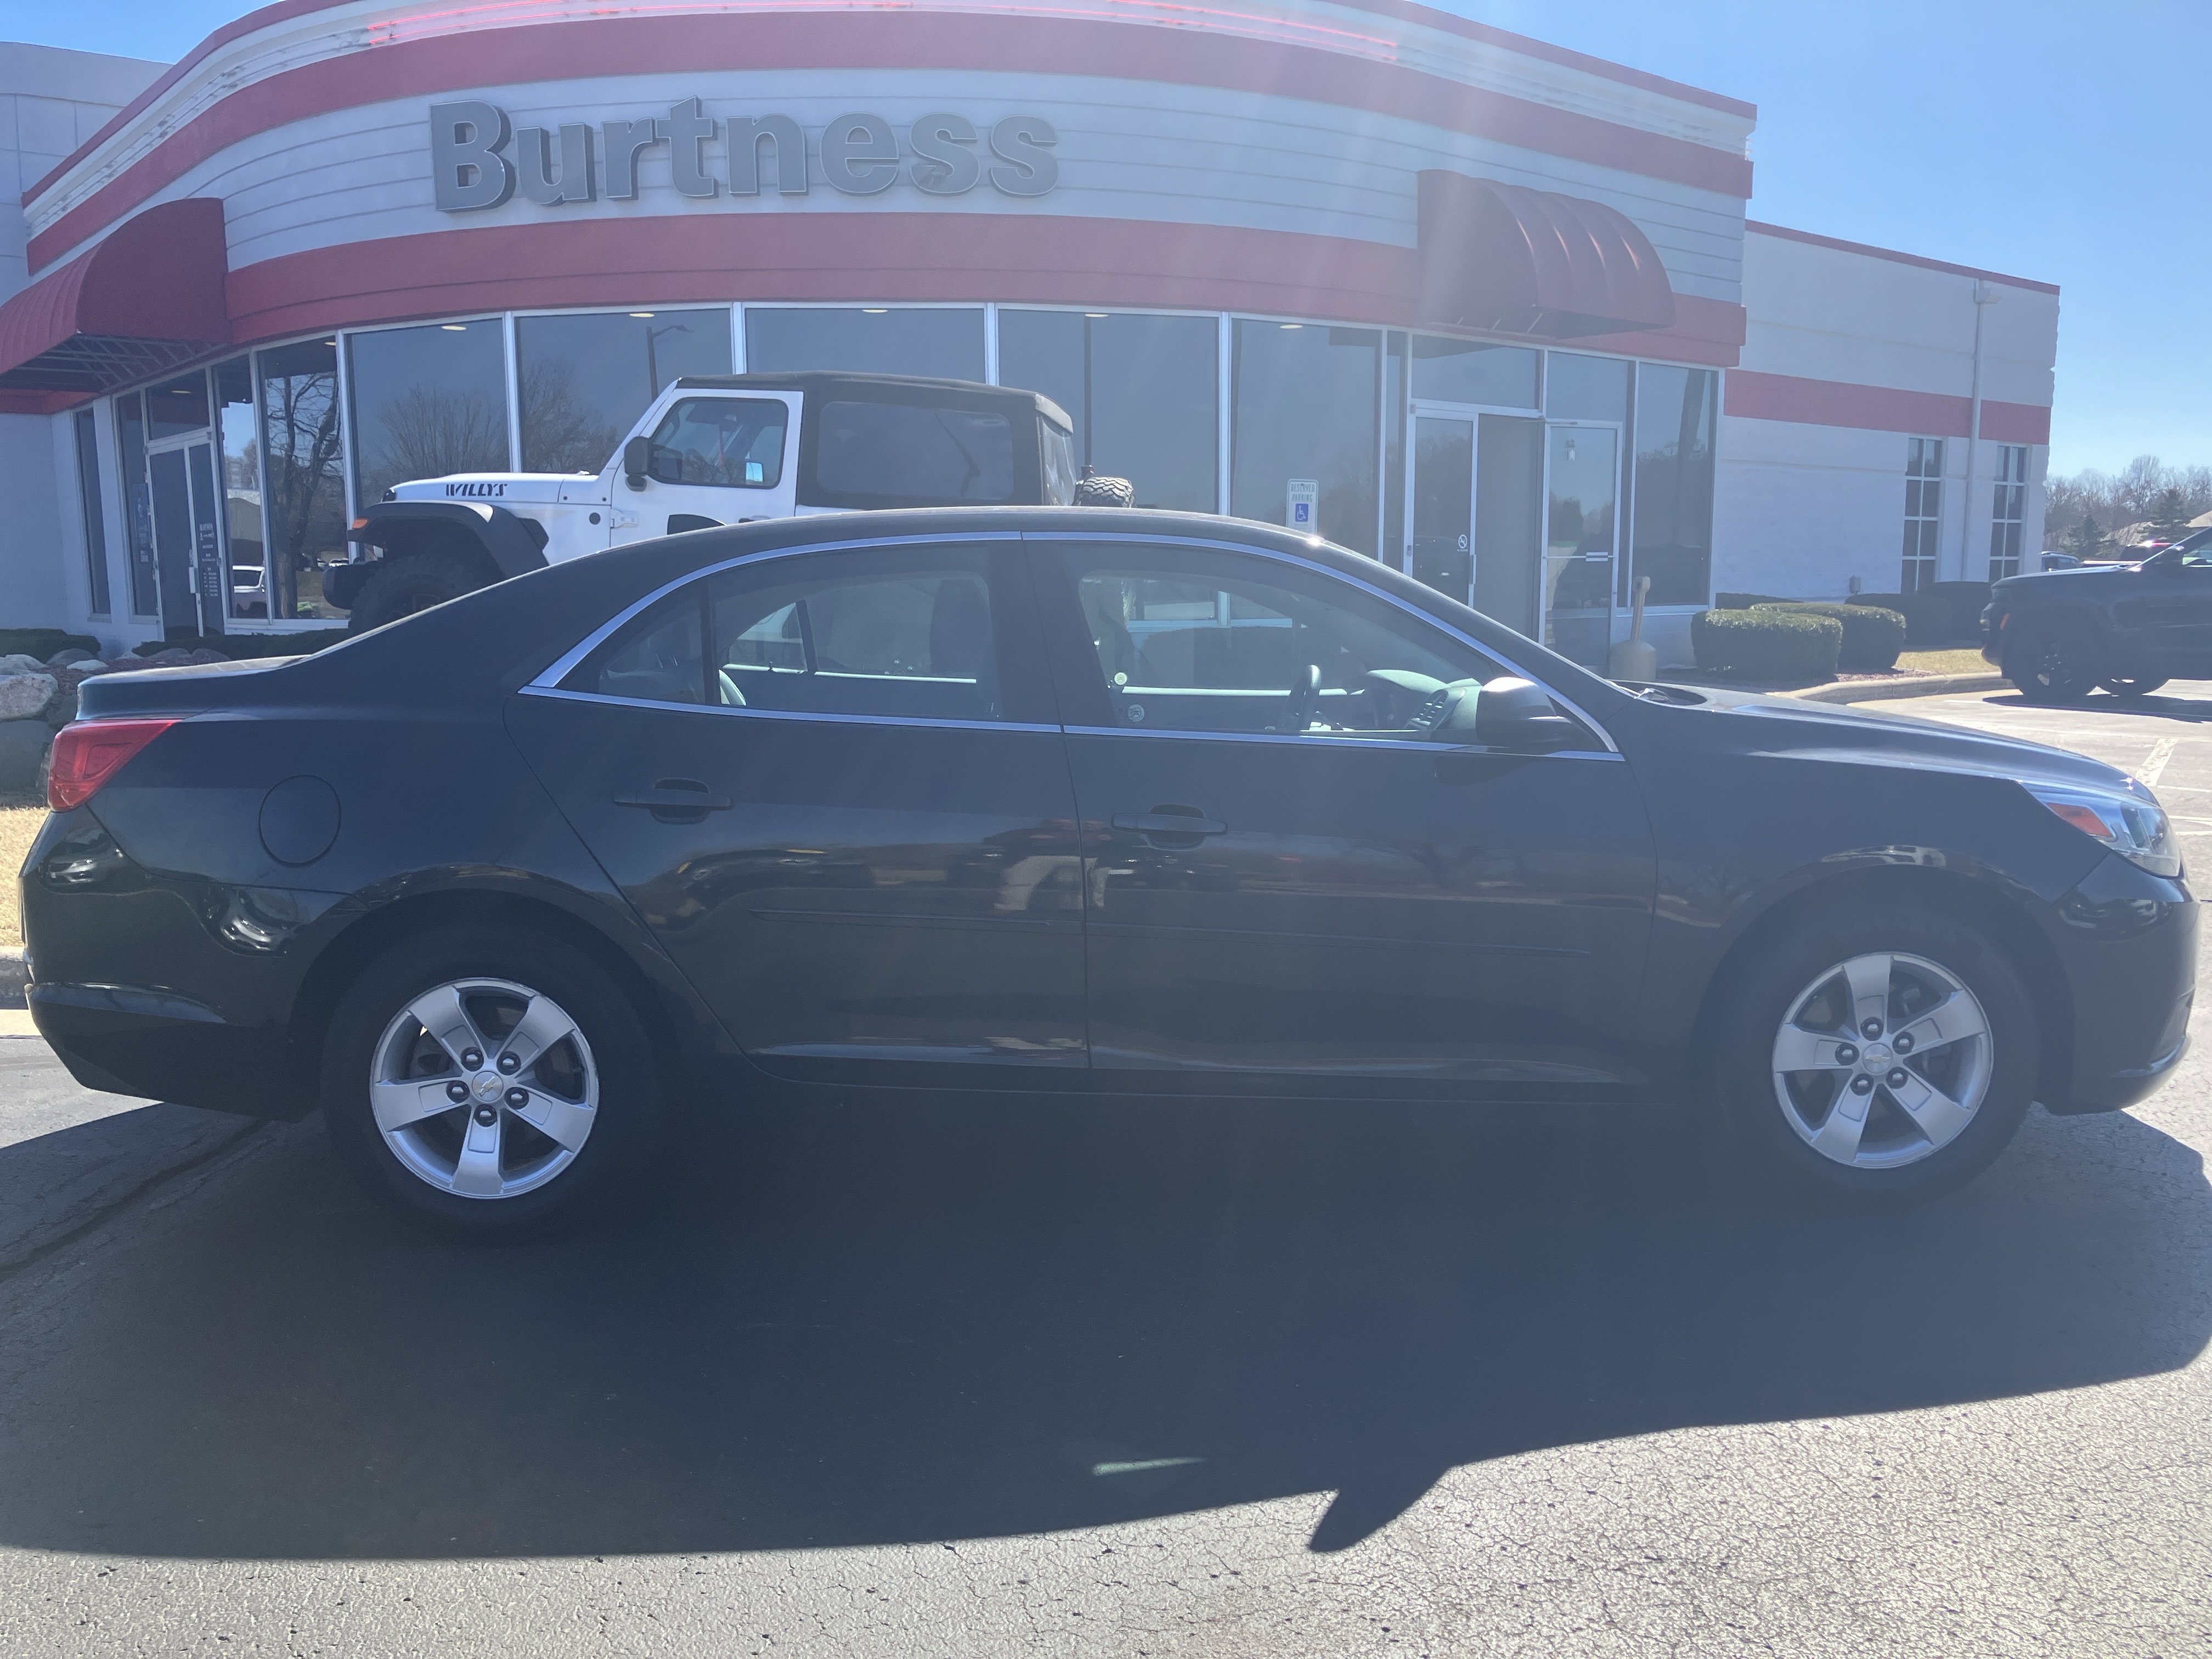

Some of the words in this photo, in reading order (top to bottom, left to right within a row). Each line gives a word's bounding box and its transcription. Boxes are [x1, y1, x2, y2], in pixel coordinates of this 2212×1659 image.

[429, 95, 1059, 212] Burtness
[446, 484, 507, 496] WILLYS
[1290, 483, 1315, 493] RESERVED
[1292, 494, 1313, 503] PARKING
